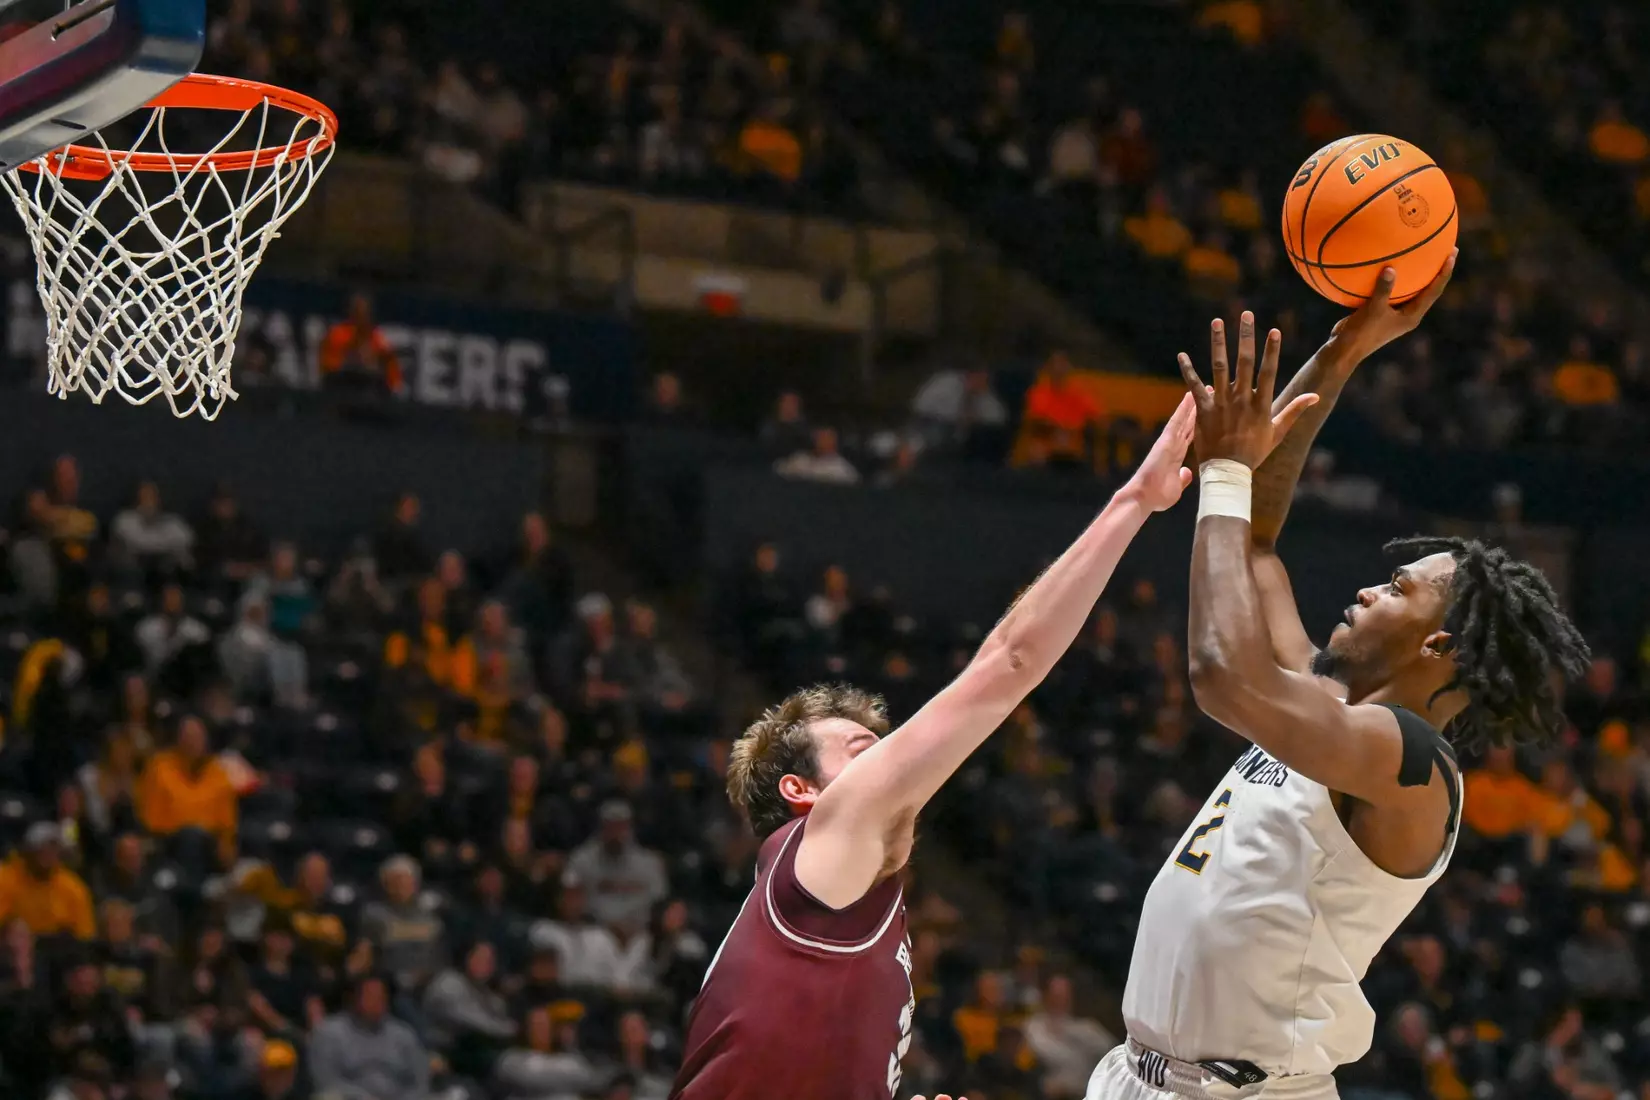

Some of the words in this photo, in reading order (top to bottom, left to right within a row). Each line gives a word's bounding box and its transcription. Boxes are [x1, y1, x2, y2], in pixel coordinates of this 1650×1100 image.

[1344, 142, 1401, 186] EVO
[1174, 787, 1232, 875] 2
[1244, 1071, 1258, 1083] 48
